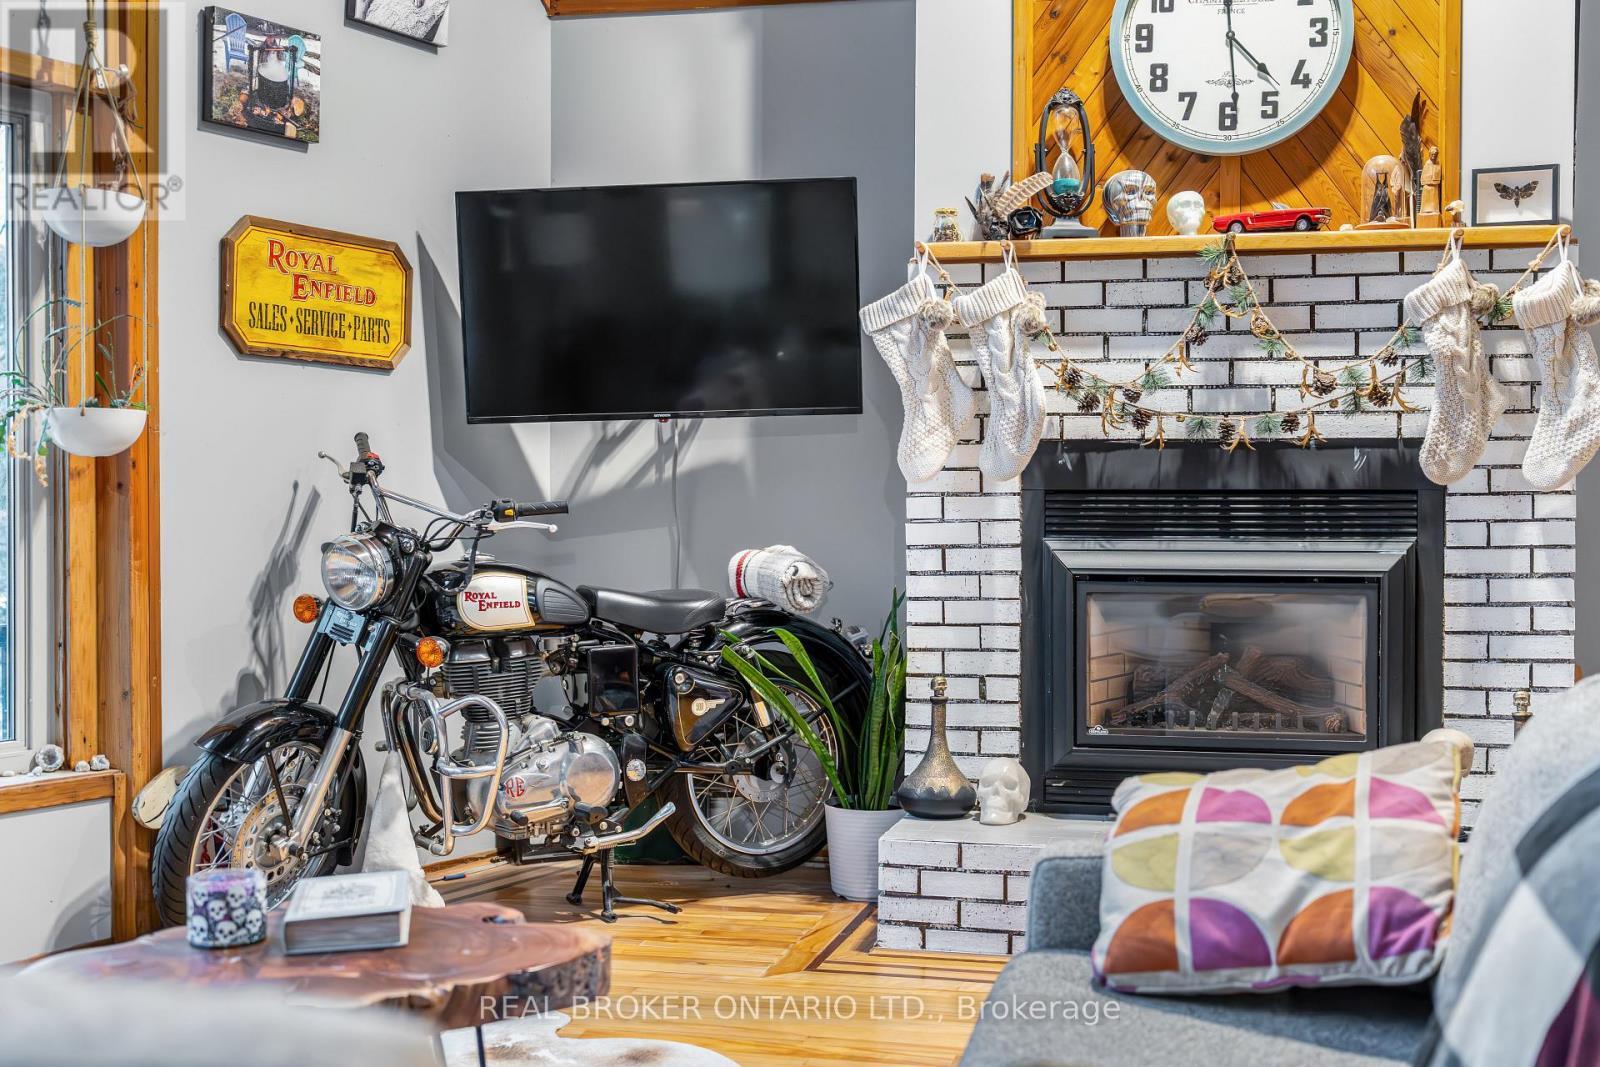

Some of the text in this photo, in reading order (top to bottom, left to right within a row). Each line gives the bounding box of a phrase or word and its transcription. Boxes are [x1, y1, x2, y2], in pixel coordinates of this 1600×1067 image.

[1124, 34, 1130, 42] 45
[1135, 24, 1153, 53] 9
[1309, 17, 1328, 47] 3
[1333, 28, 1339, 36] 15
[1149, 63, 1168, 92] 8
[1291, 59, 1312, 88] 4
[1316, 78, 1324, 88] 20
[1135, 84, 1143, 93] 40
[1178, 91, 1197, 120] 7
[1218, 102, 1238, 131] 6
[1261, 91, 1279, 119] 5
[1171, 121, 1180, 130] 35
[1275, 119, 1285, 127] 25
[267, 239, 338, 275] ROYAL
[291, 273, 377, 306] ENFIELD
[249, 301, 390, 344] SALES SERVICE PARTS
[464, 591, 497, 603] ROYAL
[478, 600, 521, 612] ENFIELD
